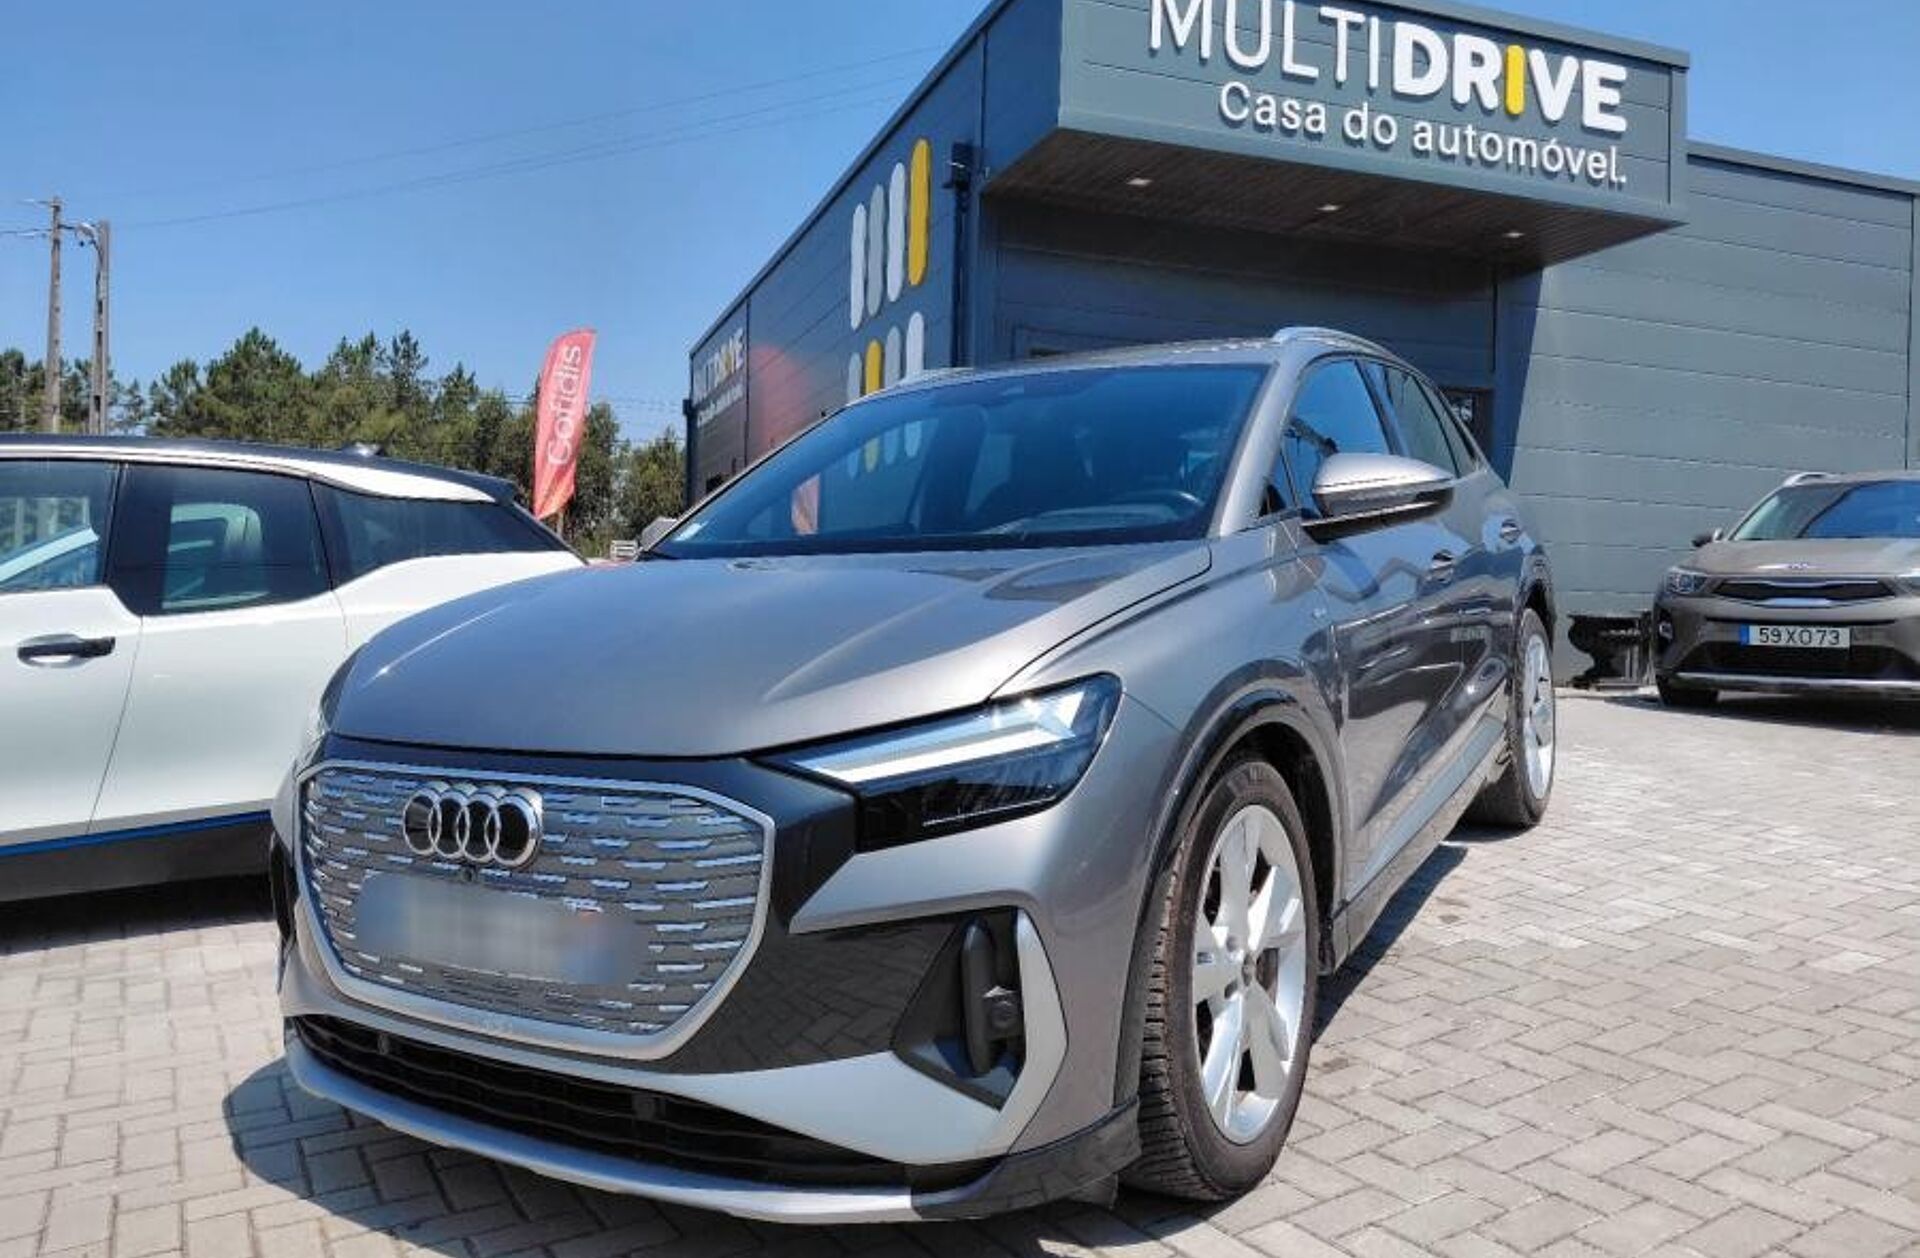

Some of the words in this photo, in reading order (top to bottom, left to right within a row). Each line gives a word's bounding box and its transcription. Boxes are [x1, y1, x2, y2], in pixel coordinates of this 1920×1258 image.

[1220, 81, 1327, 134] Casa
[1343, 102, 1397, 145] do
[1413, 120, 1627, 184] automóvel.
